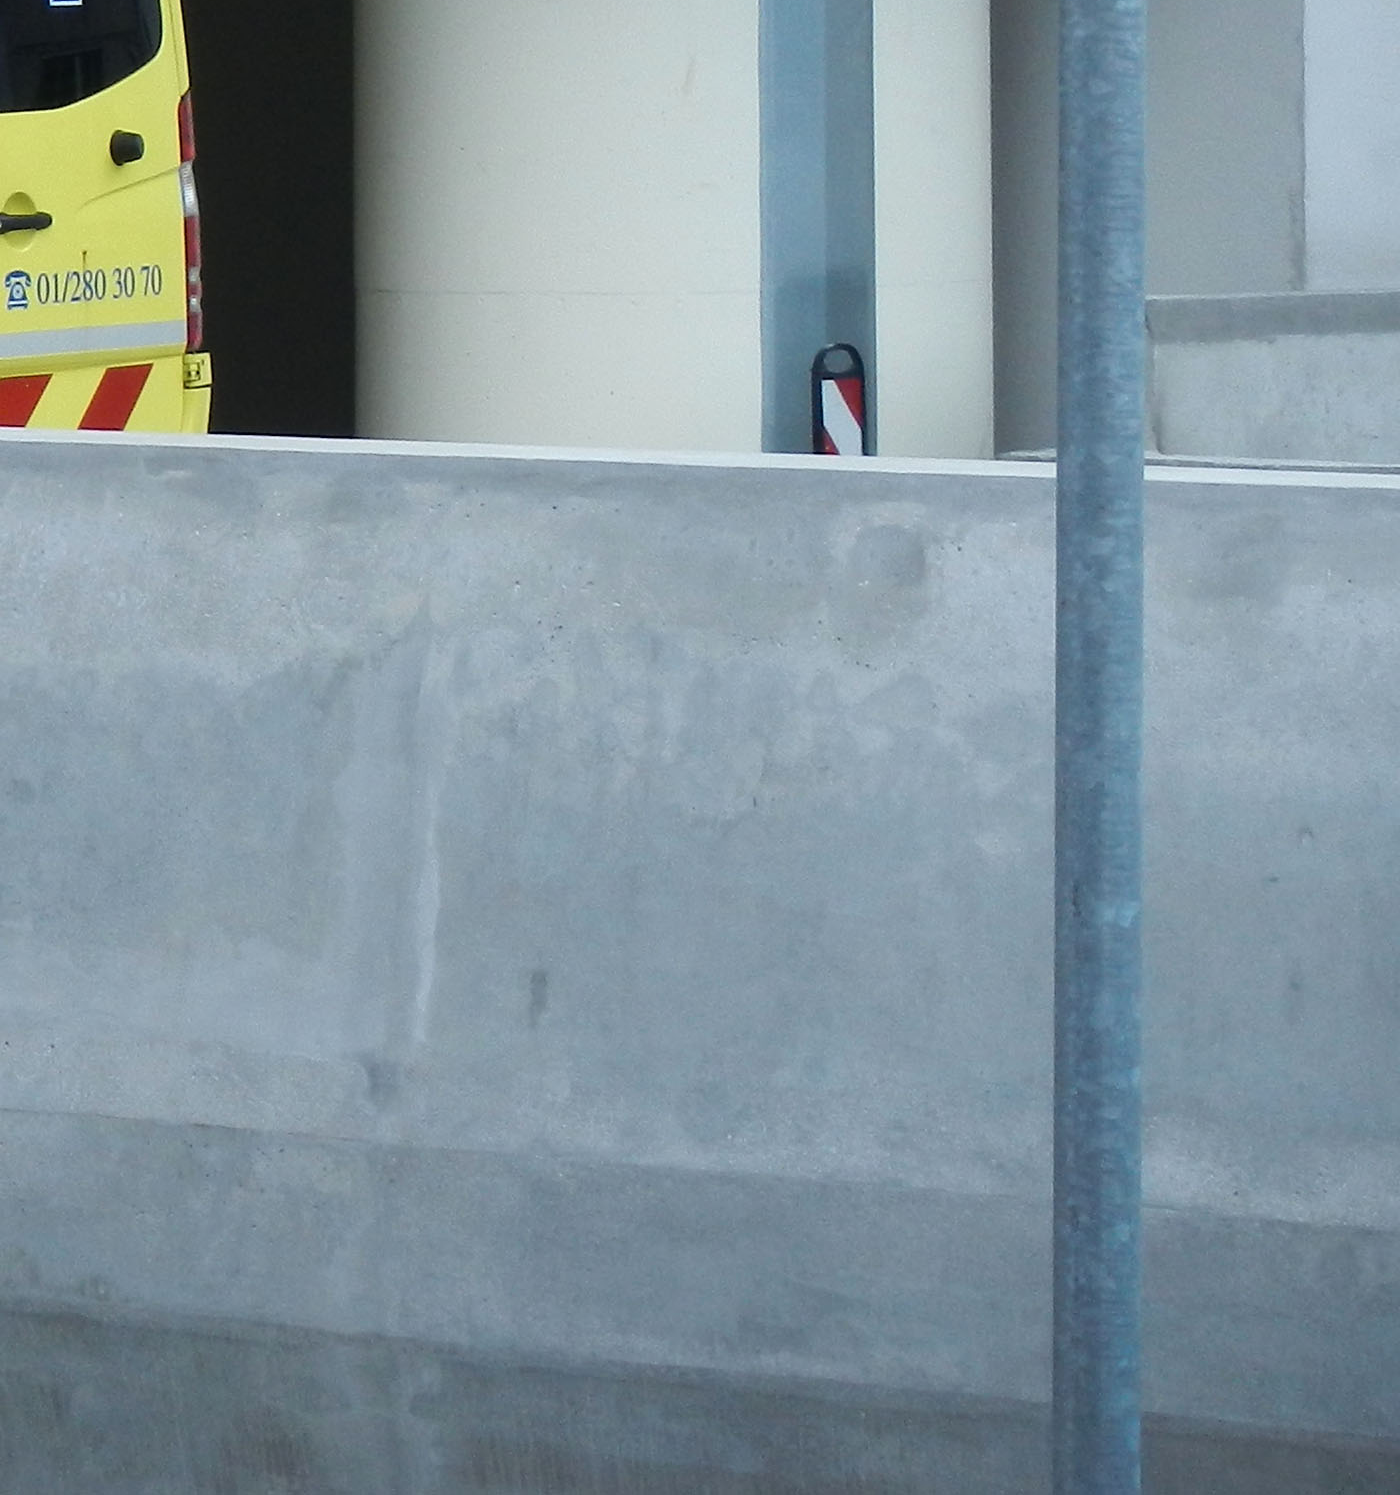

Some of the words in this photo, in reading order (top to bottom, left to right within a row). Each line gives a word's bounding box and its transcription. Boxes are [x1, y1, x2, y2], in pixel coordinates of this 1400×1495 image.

[36, 269, 107, 305] 01/280
[112, 266, 136, 299] 30
[140, 264, 162, 296] 70
